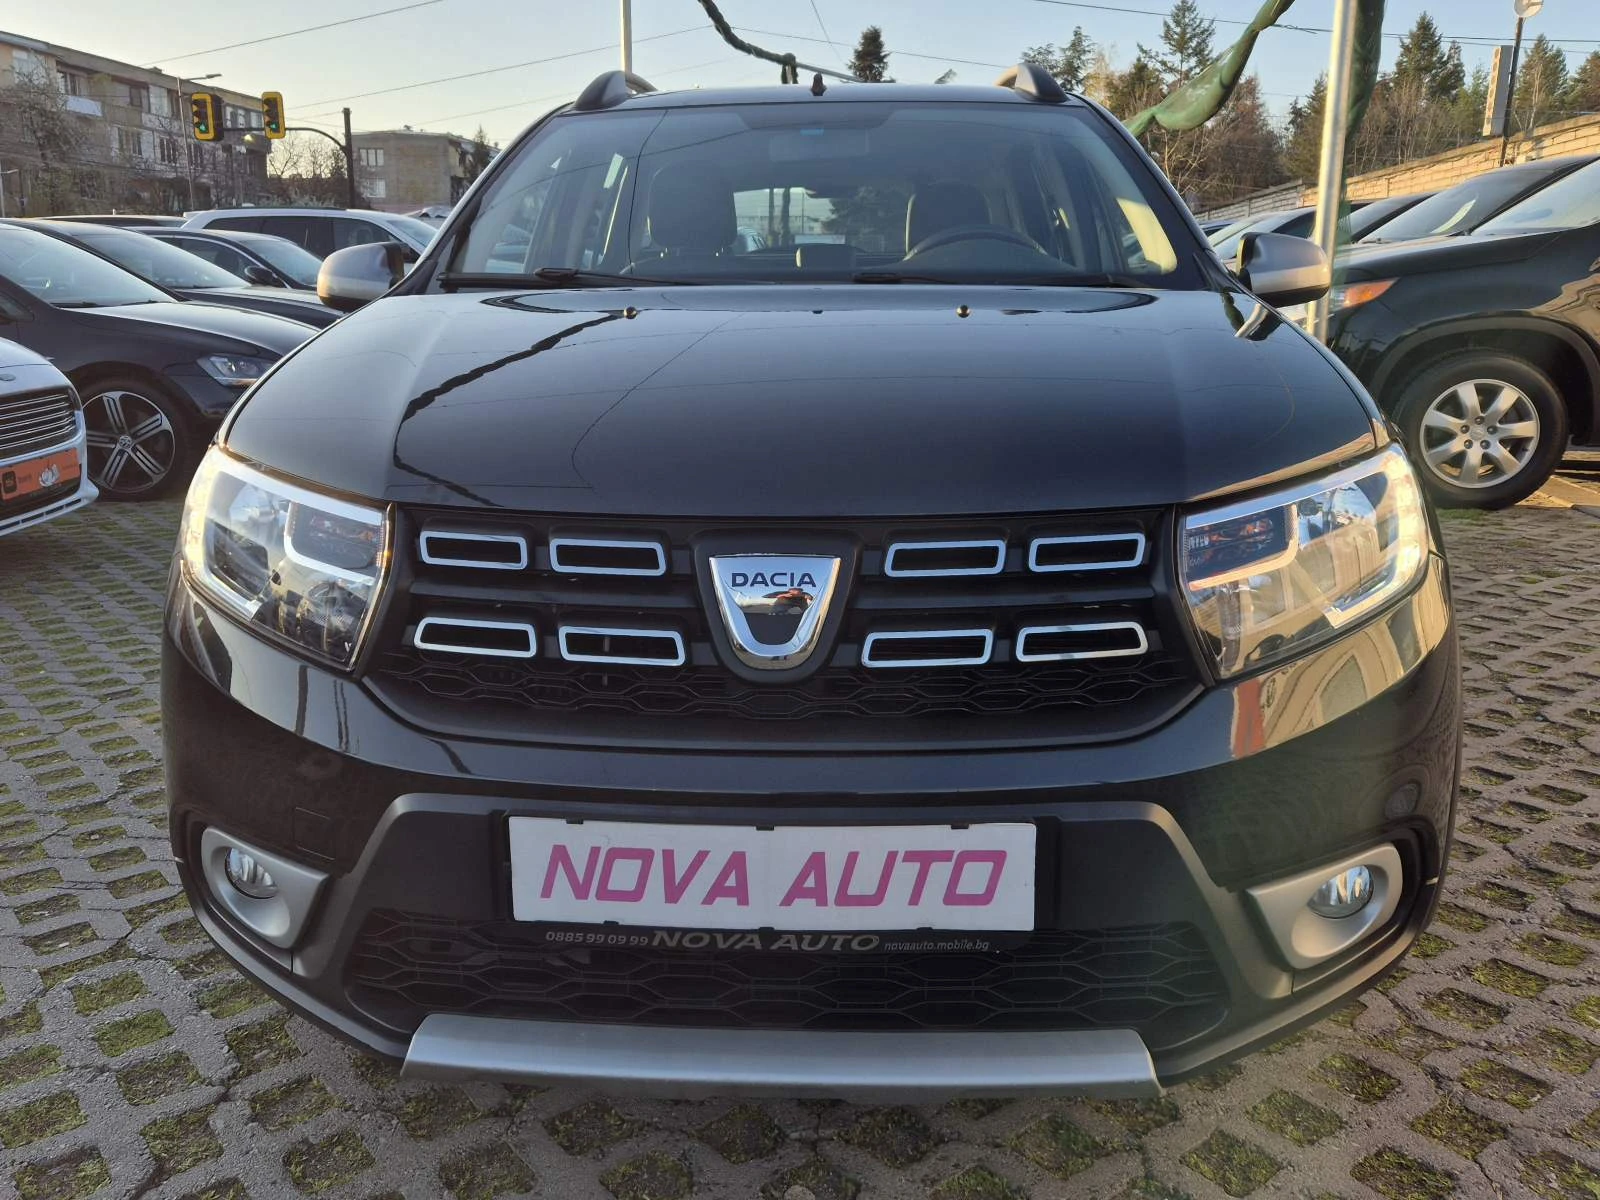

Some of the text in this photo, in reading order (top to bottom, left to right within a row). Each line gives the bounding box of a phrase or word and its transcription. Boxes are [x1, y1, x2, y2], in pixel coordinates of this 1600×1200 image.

[731, 572, 817, 588] DACIA
[540, 844, 1008, 907] NOVA AUTO
[545, 931, 584, 943] 0885
[585, 933, 606, 944] 99
[629, 935, 649, 946] 99
[651, 929, 762, 950] NOVA
[770, 934, 880, 951] AUTO
